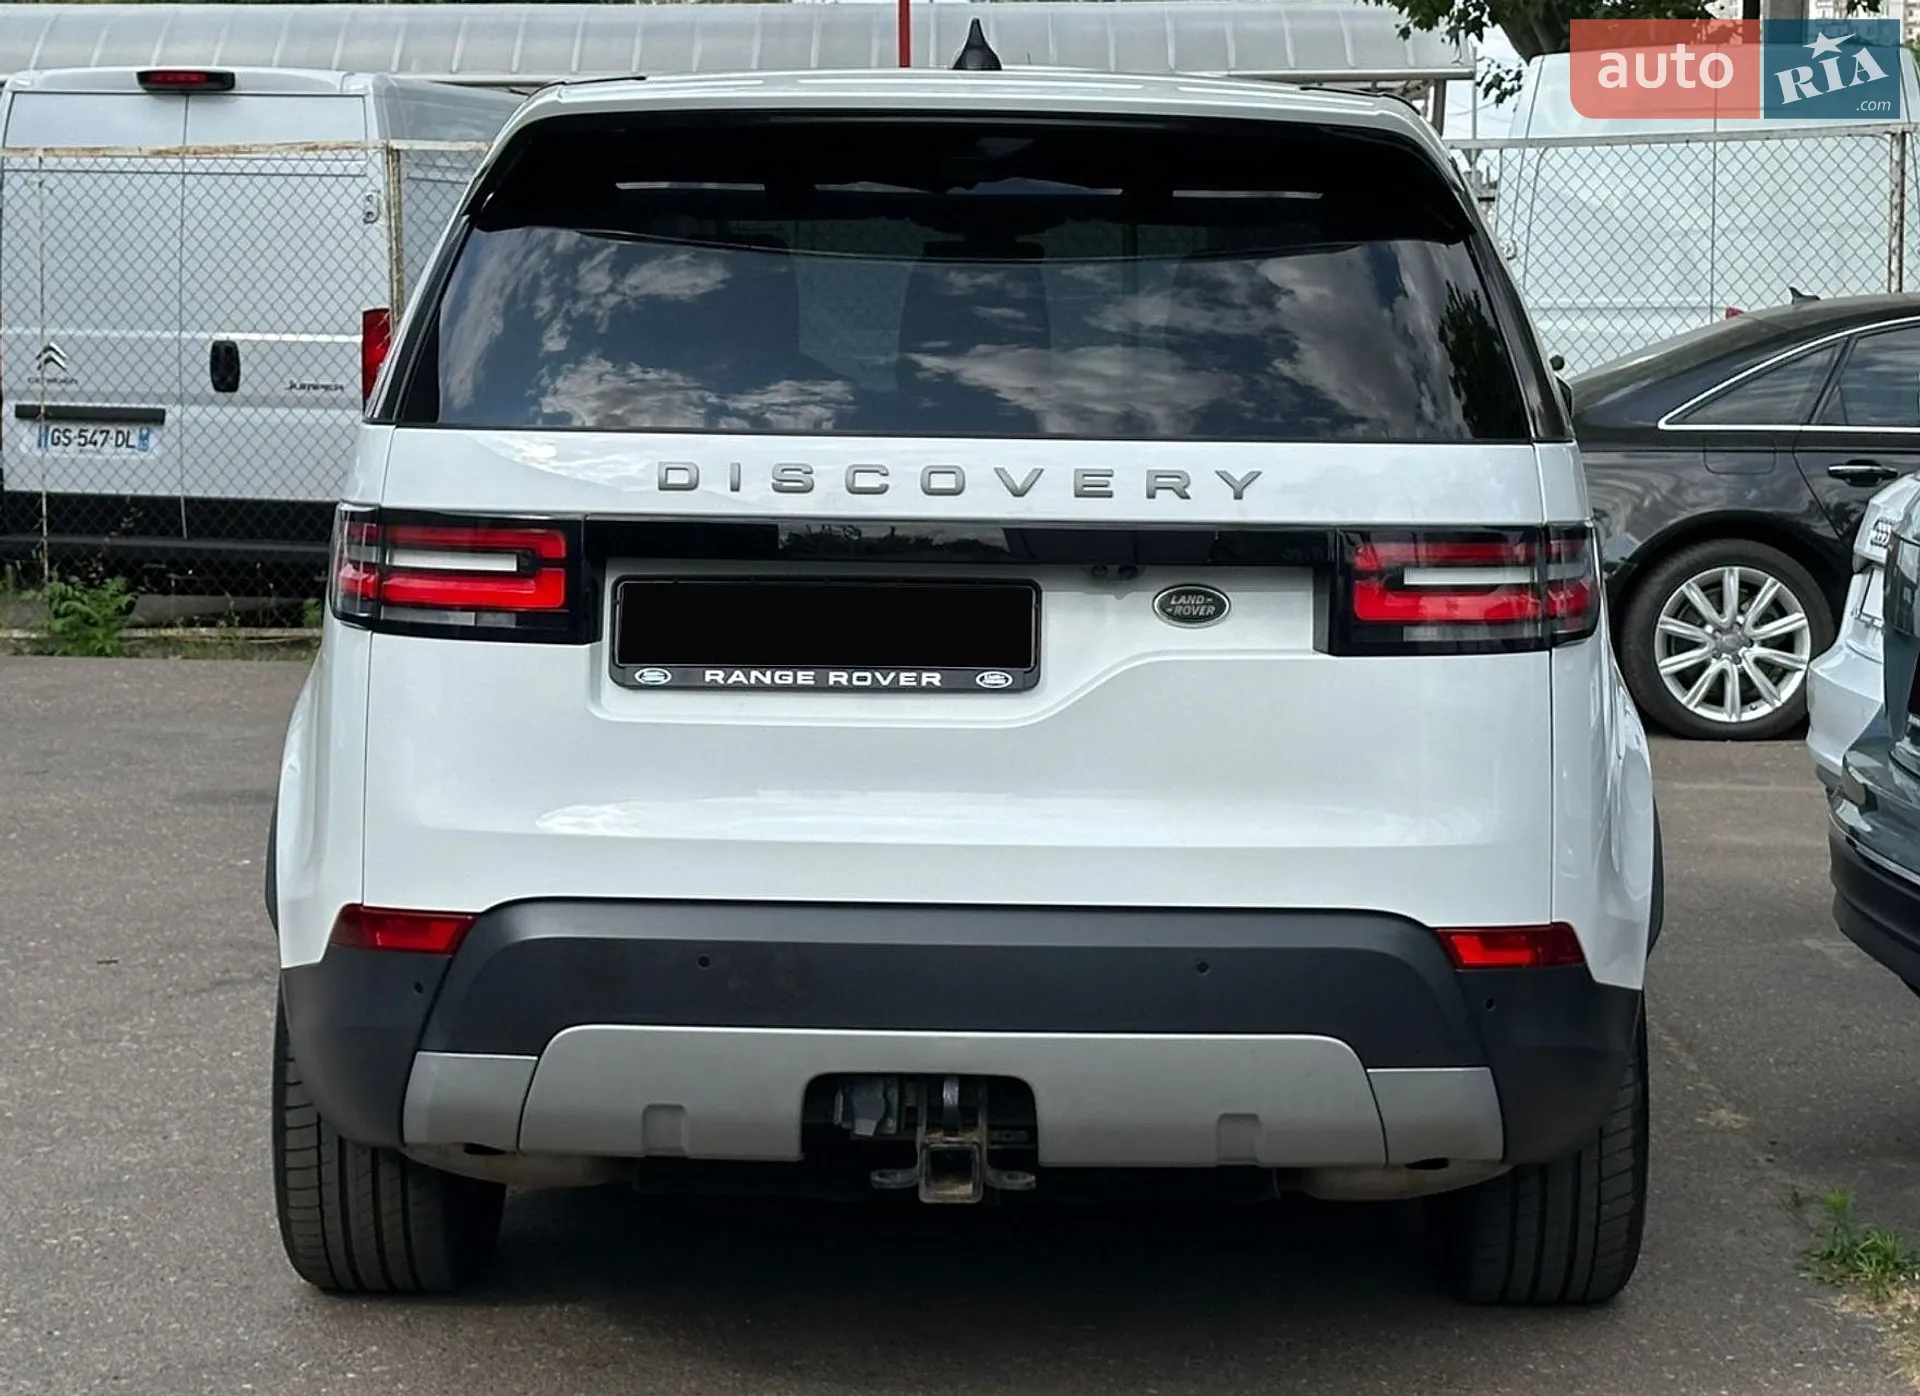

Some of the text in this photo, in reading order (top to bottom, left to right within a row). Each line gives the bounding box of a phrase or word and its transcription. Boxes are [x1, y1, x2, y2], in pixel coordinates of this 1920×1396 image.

[657, 461, 1262, 500] DISCOVERY
[704, 669, 942, 686] RANGE ROVER
